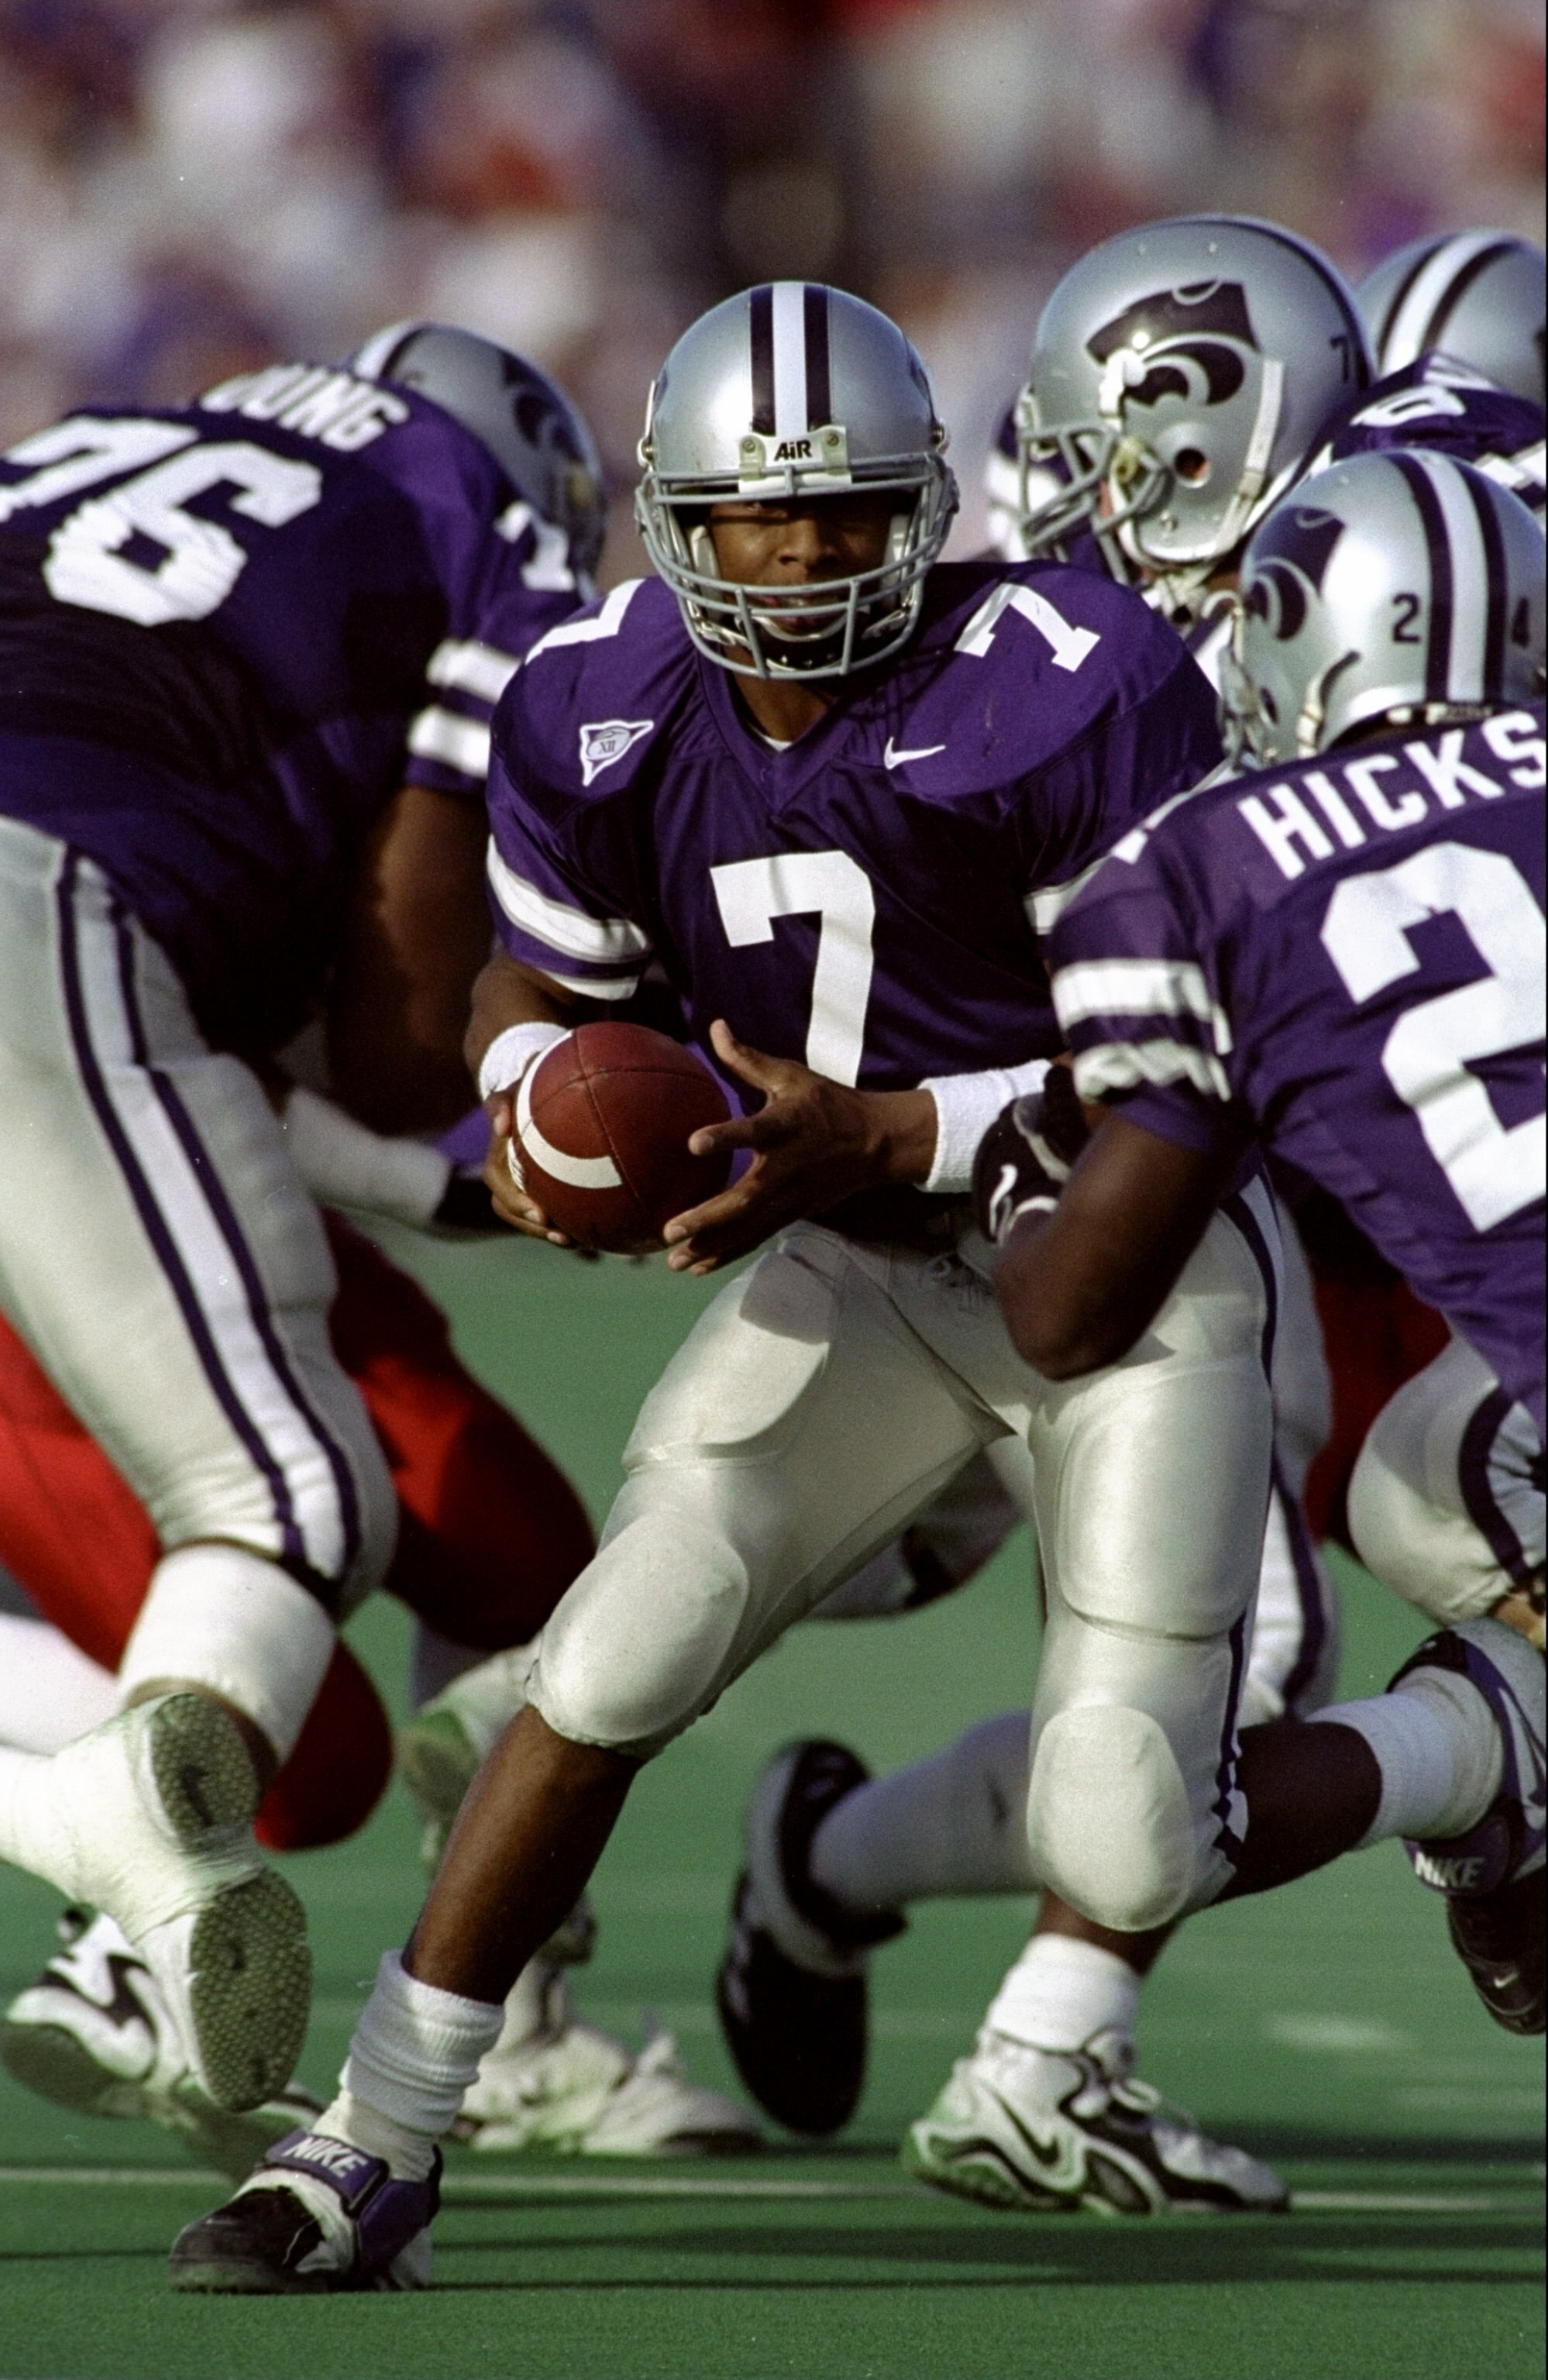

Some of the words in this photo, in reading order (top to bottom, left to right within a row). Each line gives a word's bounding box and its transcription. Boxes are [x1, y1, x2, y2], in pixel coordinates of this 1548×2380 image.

[0, 414, 323, 628] 76
[953, 583, 1102, 672] 7
[1392, 593, 1421, 644] 2
[1237, 710, 1546, 881] HICKS
[710, 850, 876, 1089] 7
[1415, 1851, 1487, 1889] NIKE
[281, 2136, 370, 2179] NIKE
